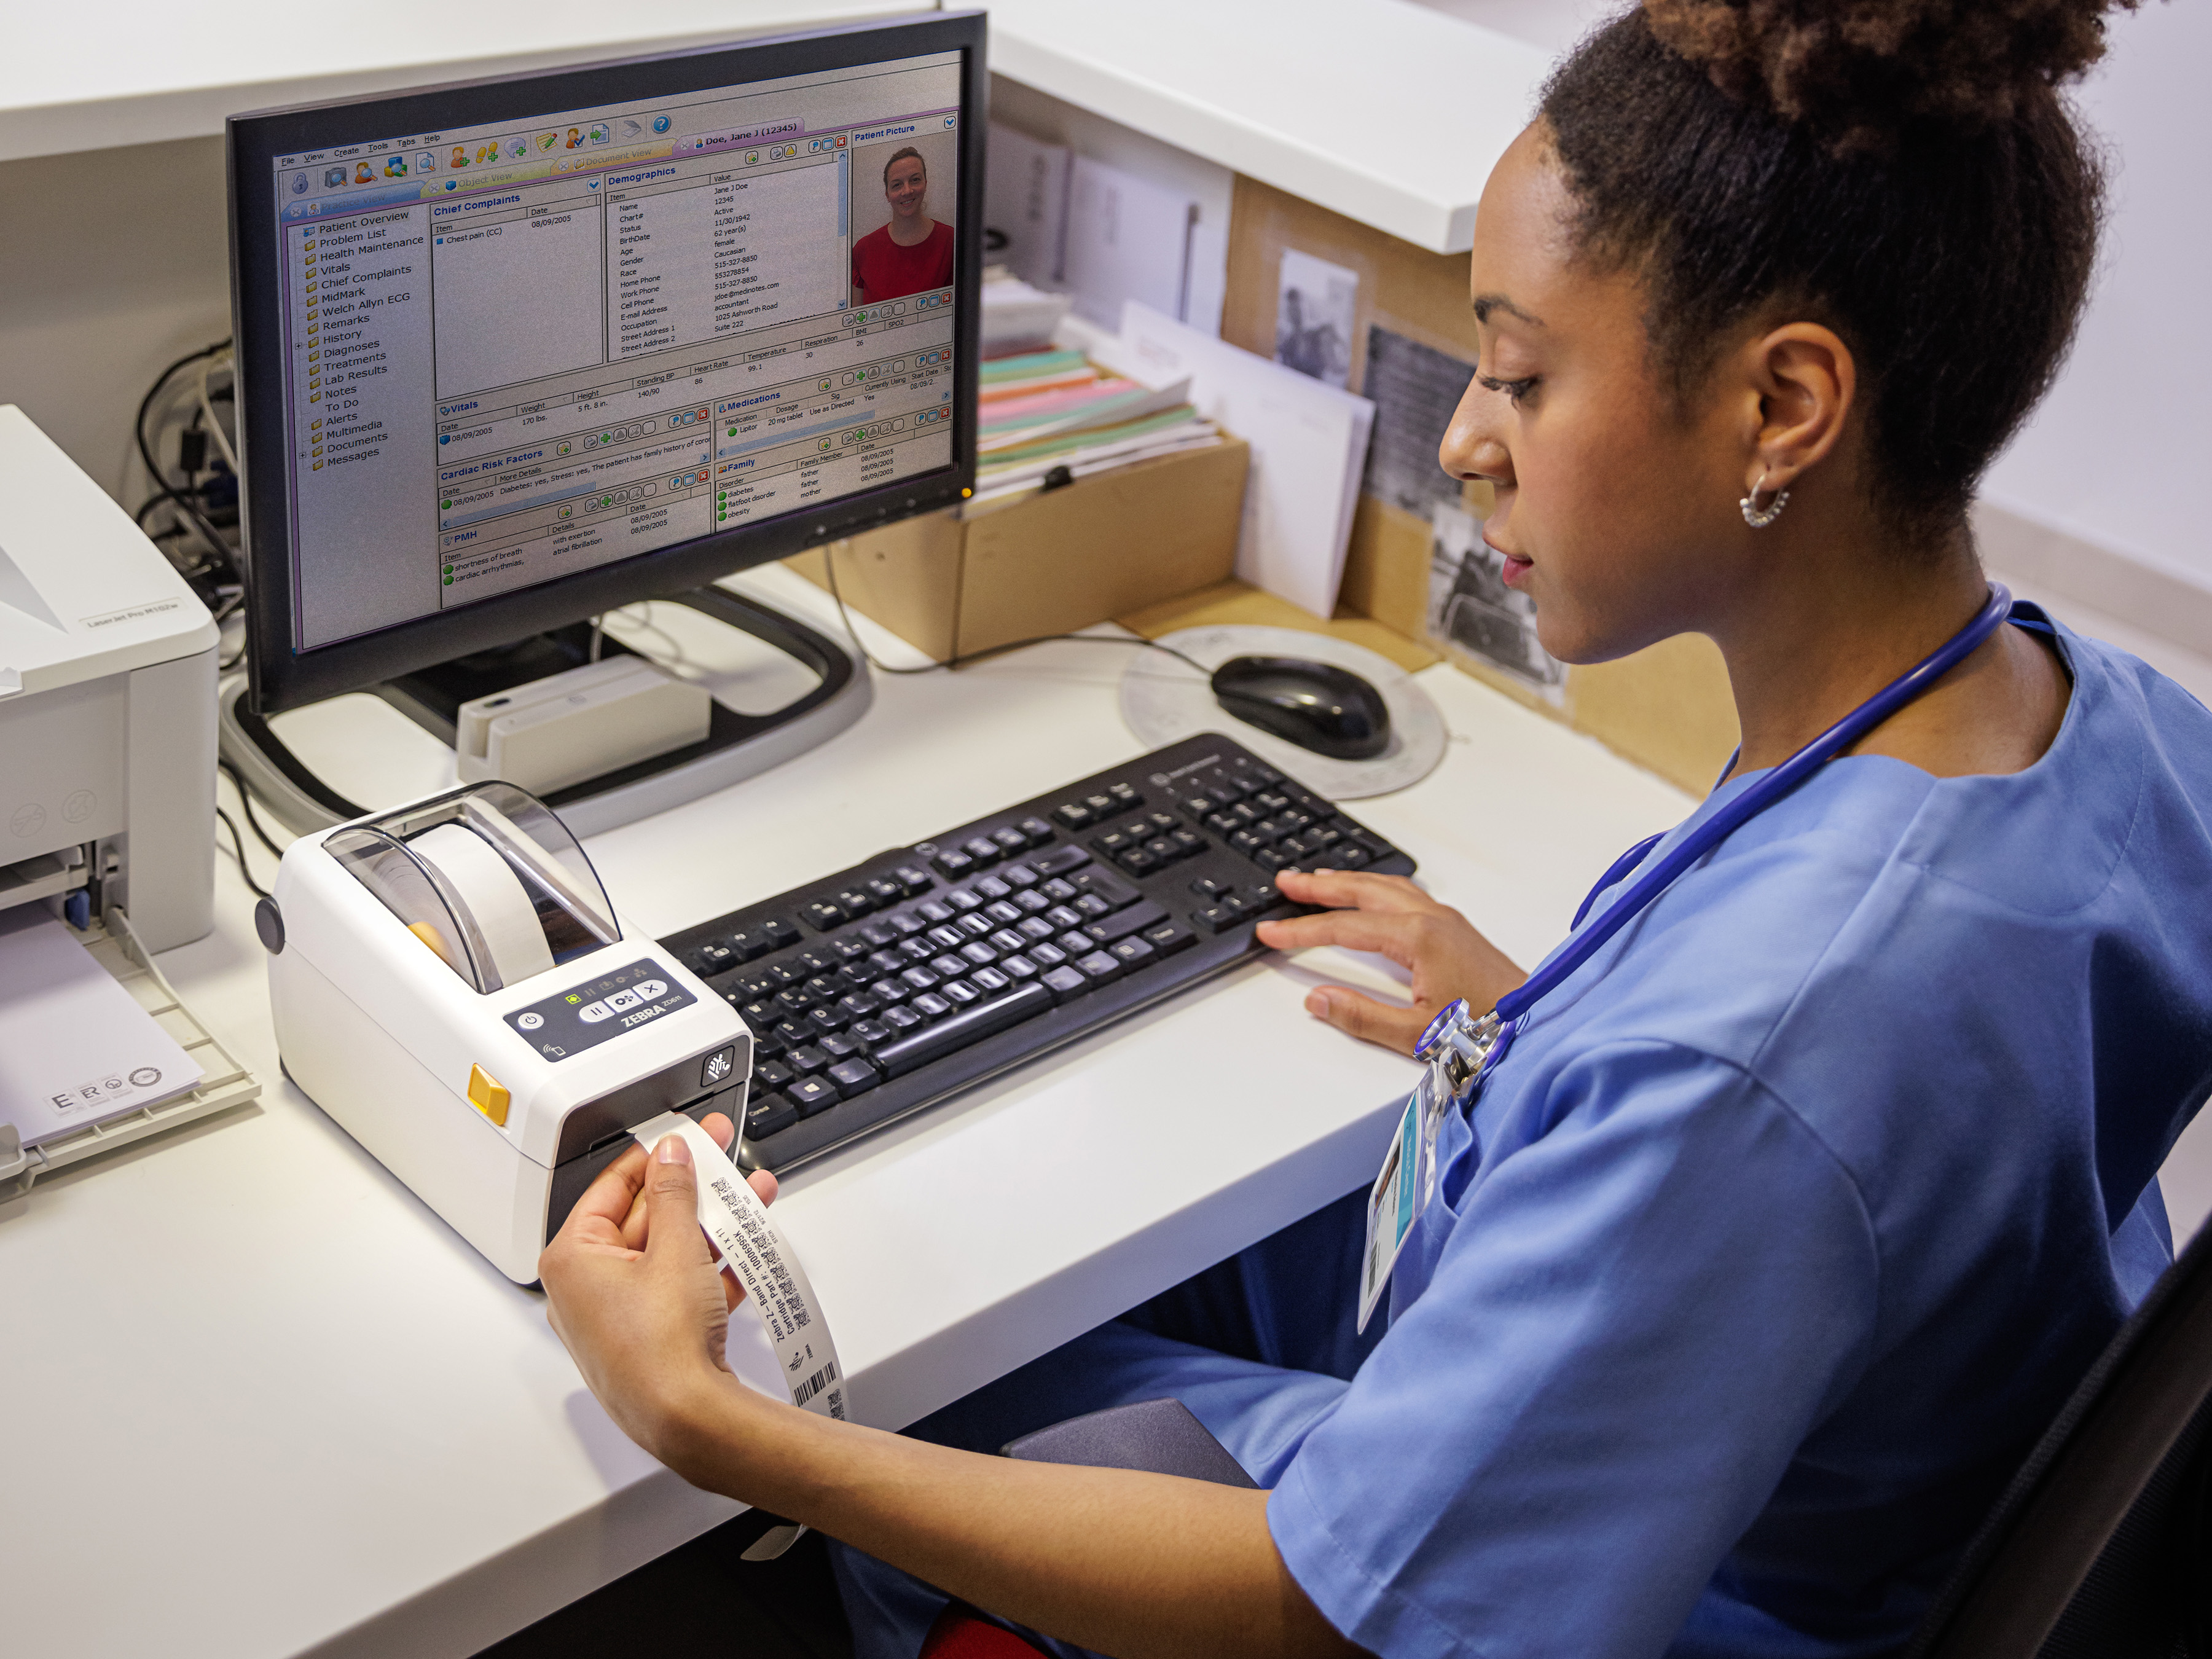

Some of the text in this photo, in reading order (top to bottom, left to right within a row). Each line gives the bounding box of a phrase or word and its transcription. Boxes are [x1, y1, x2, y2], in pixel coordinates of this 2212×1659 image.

[730, 131, 751, 141] Jane
[762, 124, 796, 136] (12345)
[855, 126, 914, 141] Patient Picture
[281, 158, 294, 167] File
[304, 154, 324, 163] View
[334, 148, 359, 157] Create
[368, 143, 388, 152] Tools
[425, 135, 440, 144] Help
[609, 168, 675, 185] Demographics
[434, 195, 520, 216] Chief Complaints
[715, 196, 734, 205] 12345
[320, 213, 409, 233] Patient Overview
[531, 215, 571, 227] 08/09/2005
[620, 214, 643, 222] Chart#
[715, 214, 750, 226] 11/30/1942
[321, 229, 386, 247] Problem List
[447, 227, 502, 243] Chest pain (CC)
[620, 235, 650, 245] BirthDate
[321, 237, 423, 261] Health Maintenance
[715, 238, 735, 247] female
[715, 248, 745, 258] Caucasian
[621, 257, 643, 266] Gender
[715, 255, 757, 269] 515-327-8850
[321, 263, 350, 275] Vitals
[715, 267, 749, 279] 553278854
[322, 267, 411, 289] Chief Complaints
[715, 276, 757, 289] 515-327-8850
[322, 288, 365, 302] MidMark
[621, 290, 638, 299] Work
[715, 283, 779, 302] jdoe@medinotes.com
[323, 292, 410, 316] Welch Allyn ECG
[715, 299, 748, 311] accountant
[324, 316, 369, 330] Remarks
[621, 320, 657, 331] Occupation
[324, 331, 361, 344] History
[806, 336, 837, 347] Respiration
[324, 341, 380, 358] Diagnoses
[748, 347, 786, 361] Temperature
[324, 353, 386, 371] Treatments
[326, 366, 387, 385] Lab Results
[326, 386, 356, 398] Notes
[578, 390, 599, 401] Height
[638, 388, 659, 398] 140/90
[451, 402, 478, 412] Vitals
[521, 403, 546, 414] Weight
[728, 393, 780, 410] Medications
[326, 414, 358, 426] Alerts
[327, 422, 382, 439] Multimedia
[452, 427, 492, 441] 08/09/2005
[328, 434, 388, 452] Documents
[328, 449, 379, 466] Messages
[861, 449, 893, 461] 08/09/2005
[441, 451, 542, 480] Cardiac Risk Factors
[519, 467, 541, 477] Details
[728, 460, 755, 471] Family
[861, 458, 893, 472] 08/09/2005
[861, 468, 893, 482] 08/09/2005
[720, 479, 743, 488] Disorder
[453, 491, 493, 506] 08/09/2005
[728, 487, 753, 498] diabetes
[801, 489, 821, 498] mother
[728, 492, 775, 508] flatfoot disorder
[630, 509, 667, 524] 08/09/2005
[728, 509, 750, 518] obesity
[553, 523, 574, 533] Details
[631, 520, 667, 534] 08/09/2005
[455, 531, 477, 543] PMH
[455, 558, 488, 571] shortness
[500, 548, 522, 559] breath
[456, 560, 524, 582] cardiac arrhythmias,
[87, 614, 127, 627] LaserJet
[621, 995, 682, 1027] ZEBRA ZD611
[856, 1024, 868, 1032] C
[792, 1051, 804, 1060] Z
[715, 1228, 725, 1237] 11
[767, 1230, 778, 1244] STICH
[733, 1230, 763, 1271] 10006995K
[738, 1260, 756, 1285] Direct
[765, 1281, 778, 1298] Part
[775, 1298, 795, 1335] Cartridge
[771, 1319, 785, 1343] Zebra
